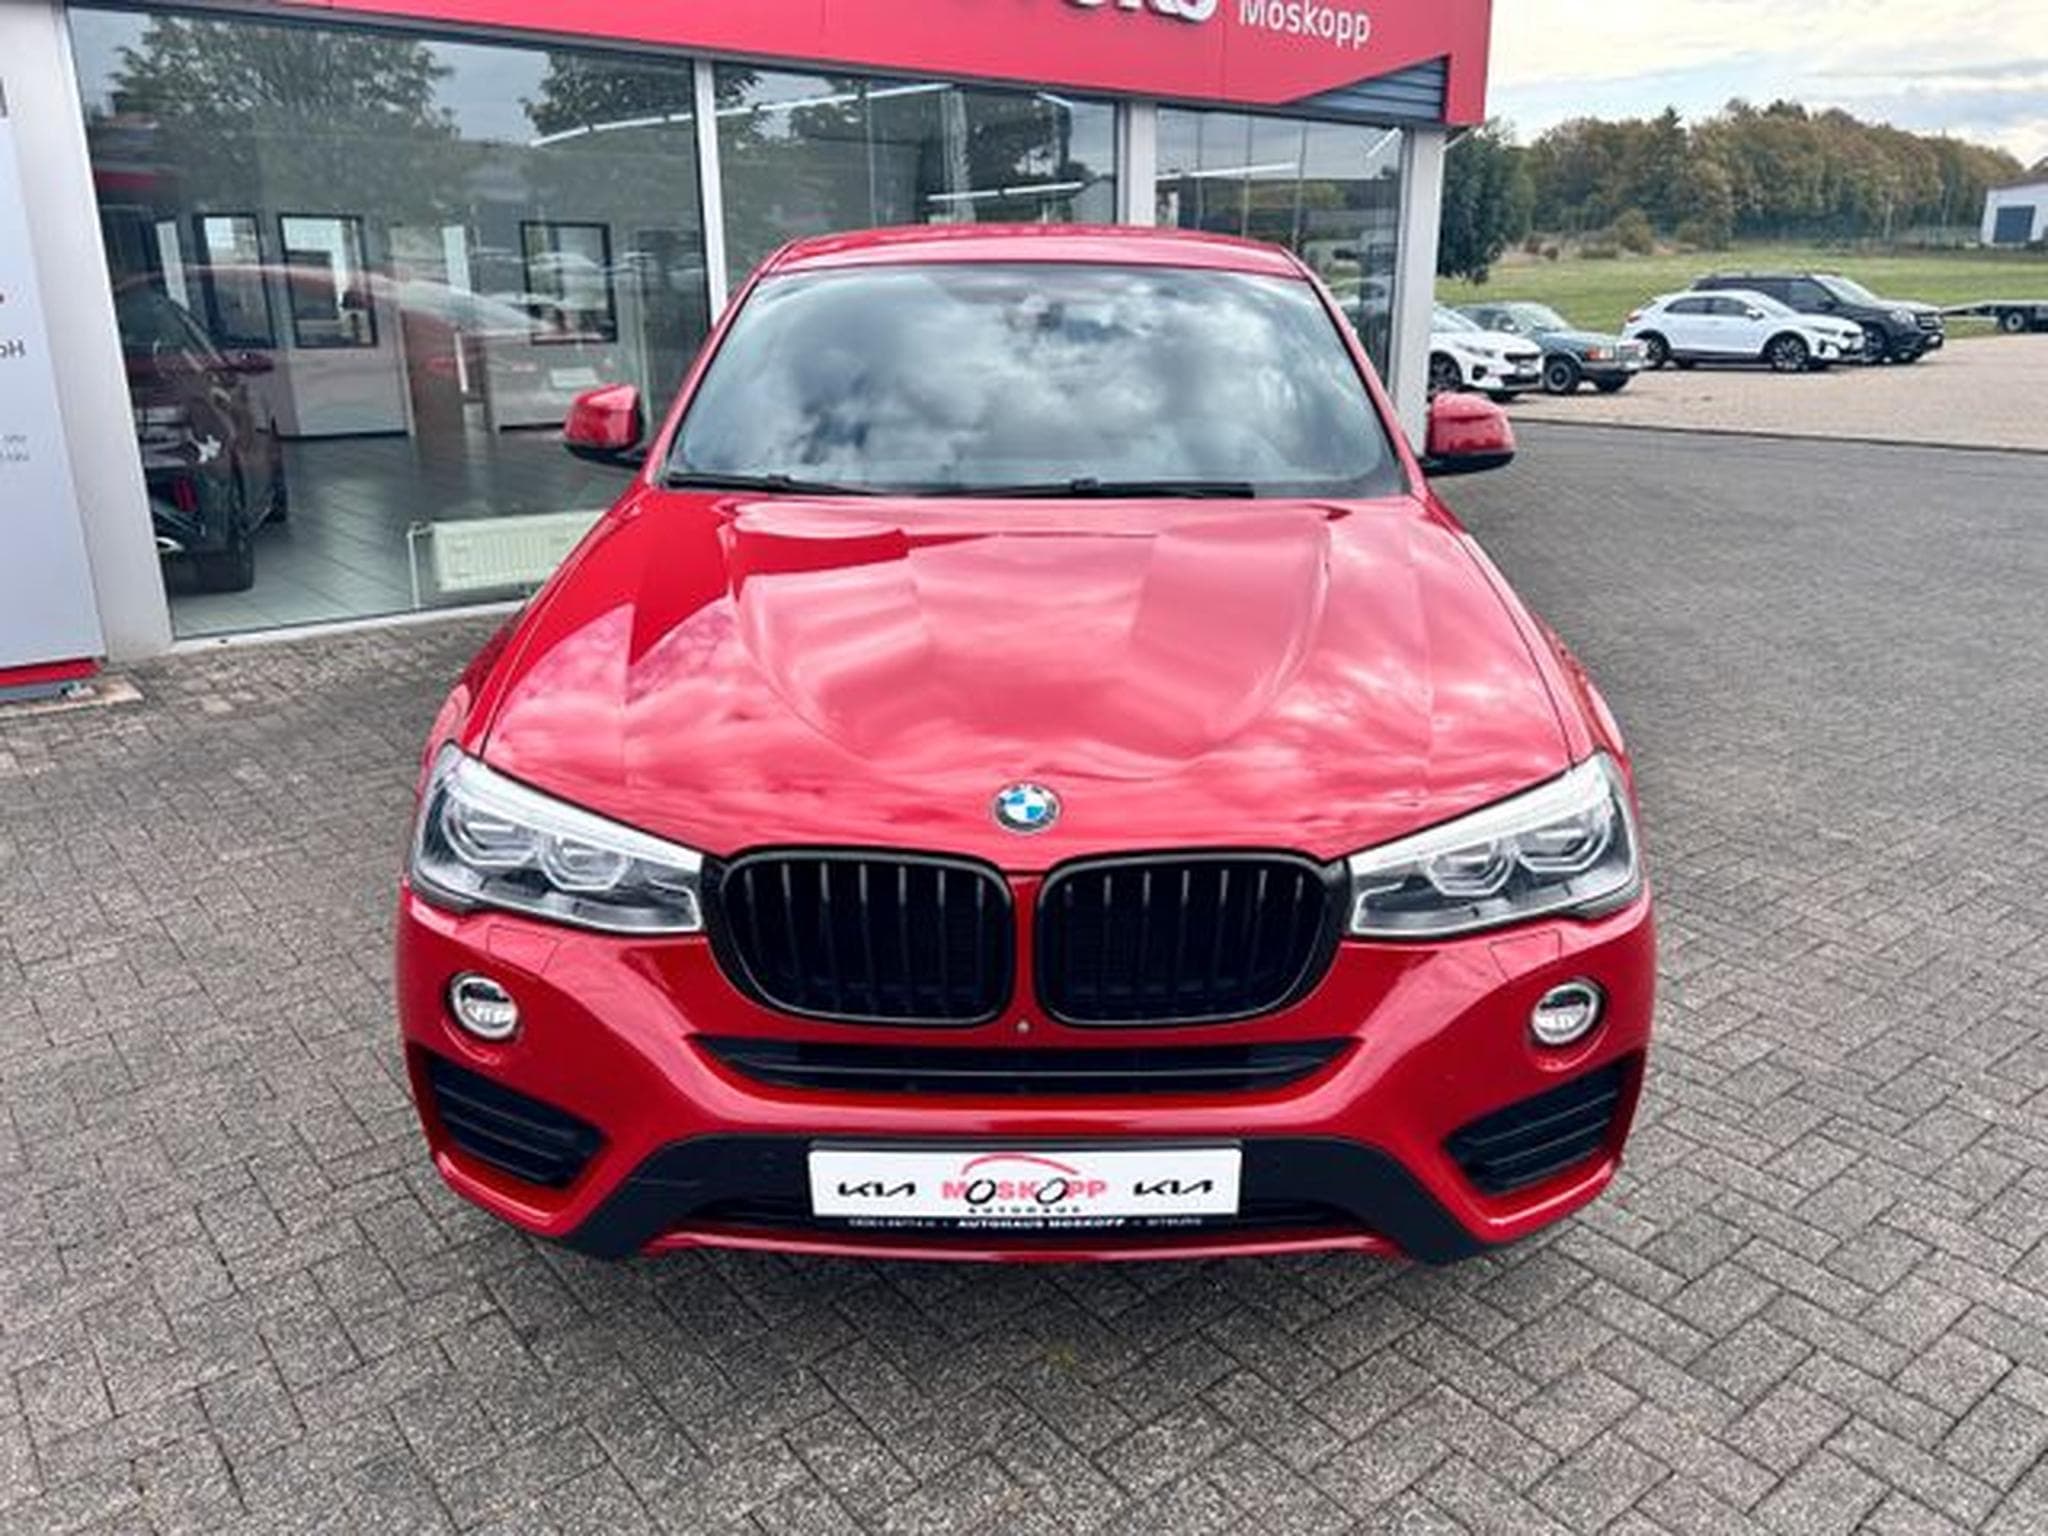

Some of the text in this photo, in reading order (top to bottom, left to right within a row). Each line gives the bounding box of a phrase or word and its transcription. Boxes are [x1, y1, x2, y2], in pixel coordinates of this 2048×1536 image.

[1238, 0, 1371, 49] Moskopp
[837, 1180, 917, 1197] KIA
[942, 1176, 1107, 1205] MOSKOPP
[1132, 1179, 1213, 1196] KIA
